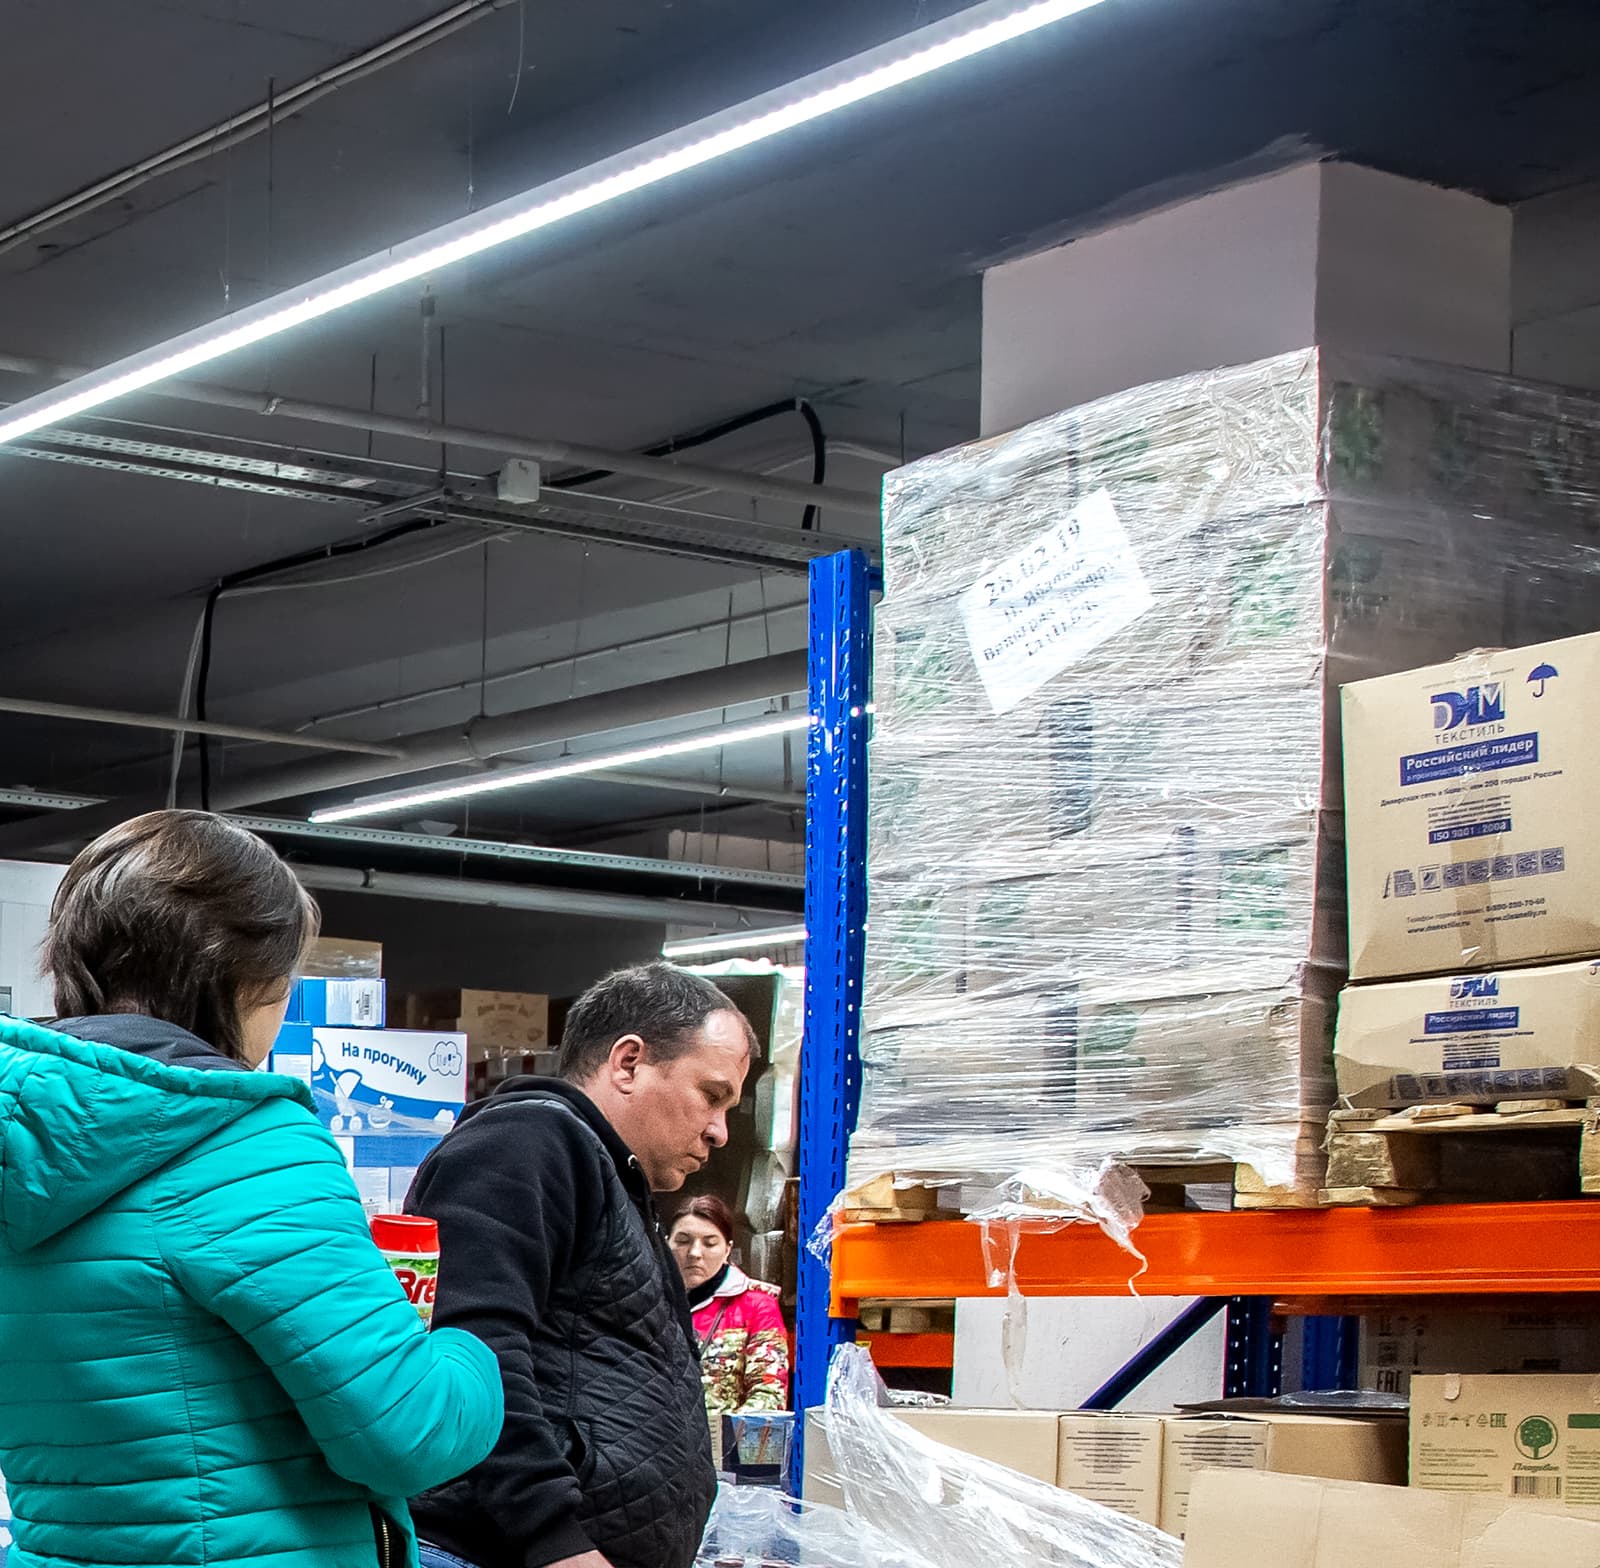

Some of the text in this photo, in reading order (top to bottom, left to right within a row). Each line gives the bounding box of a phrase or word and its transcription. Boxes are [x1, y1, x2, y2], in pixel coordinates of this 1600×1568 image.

[1435, 722, 1505, 745] ТЕКСТИЛЬ
[1406, 745, 1489, 771] Российский
[1491, 739, 1534, 756] лидер
[1433, 831, 1449, 841] ISO
[341, 1043, 427, 1086] На прогулку
[394, 1270, 435, 1304] Bre
